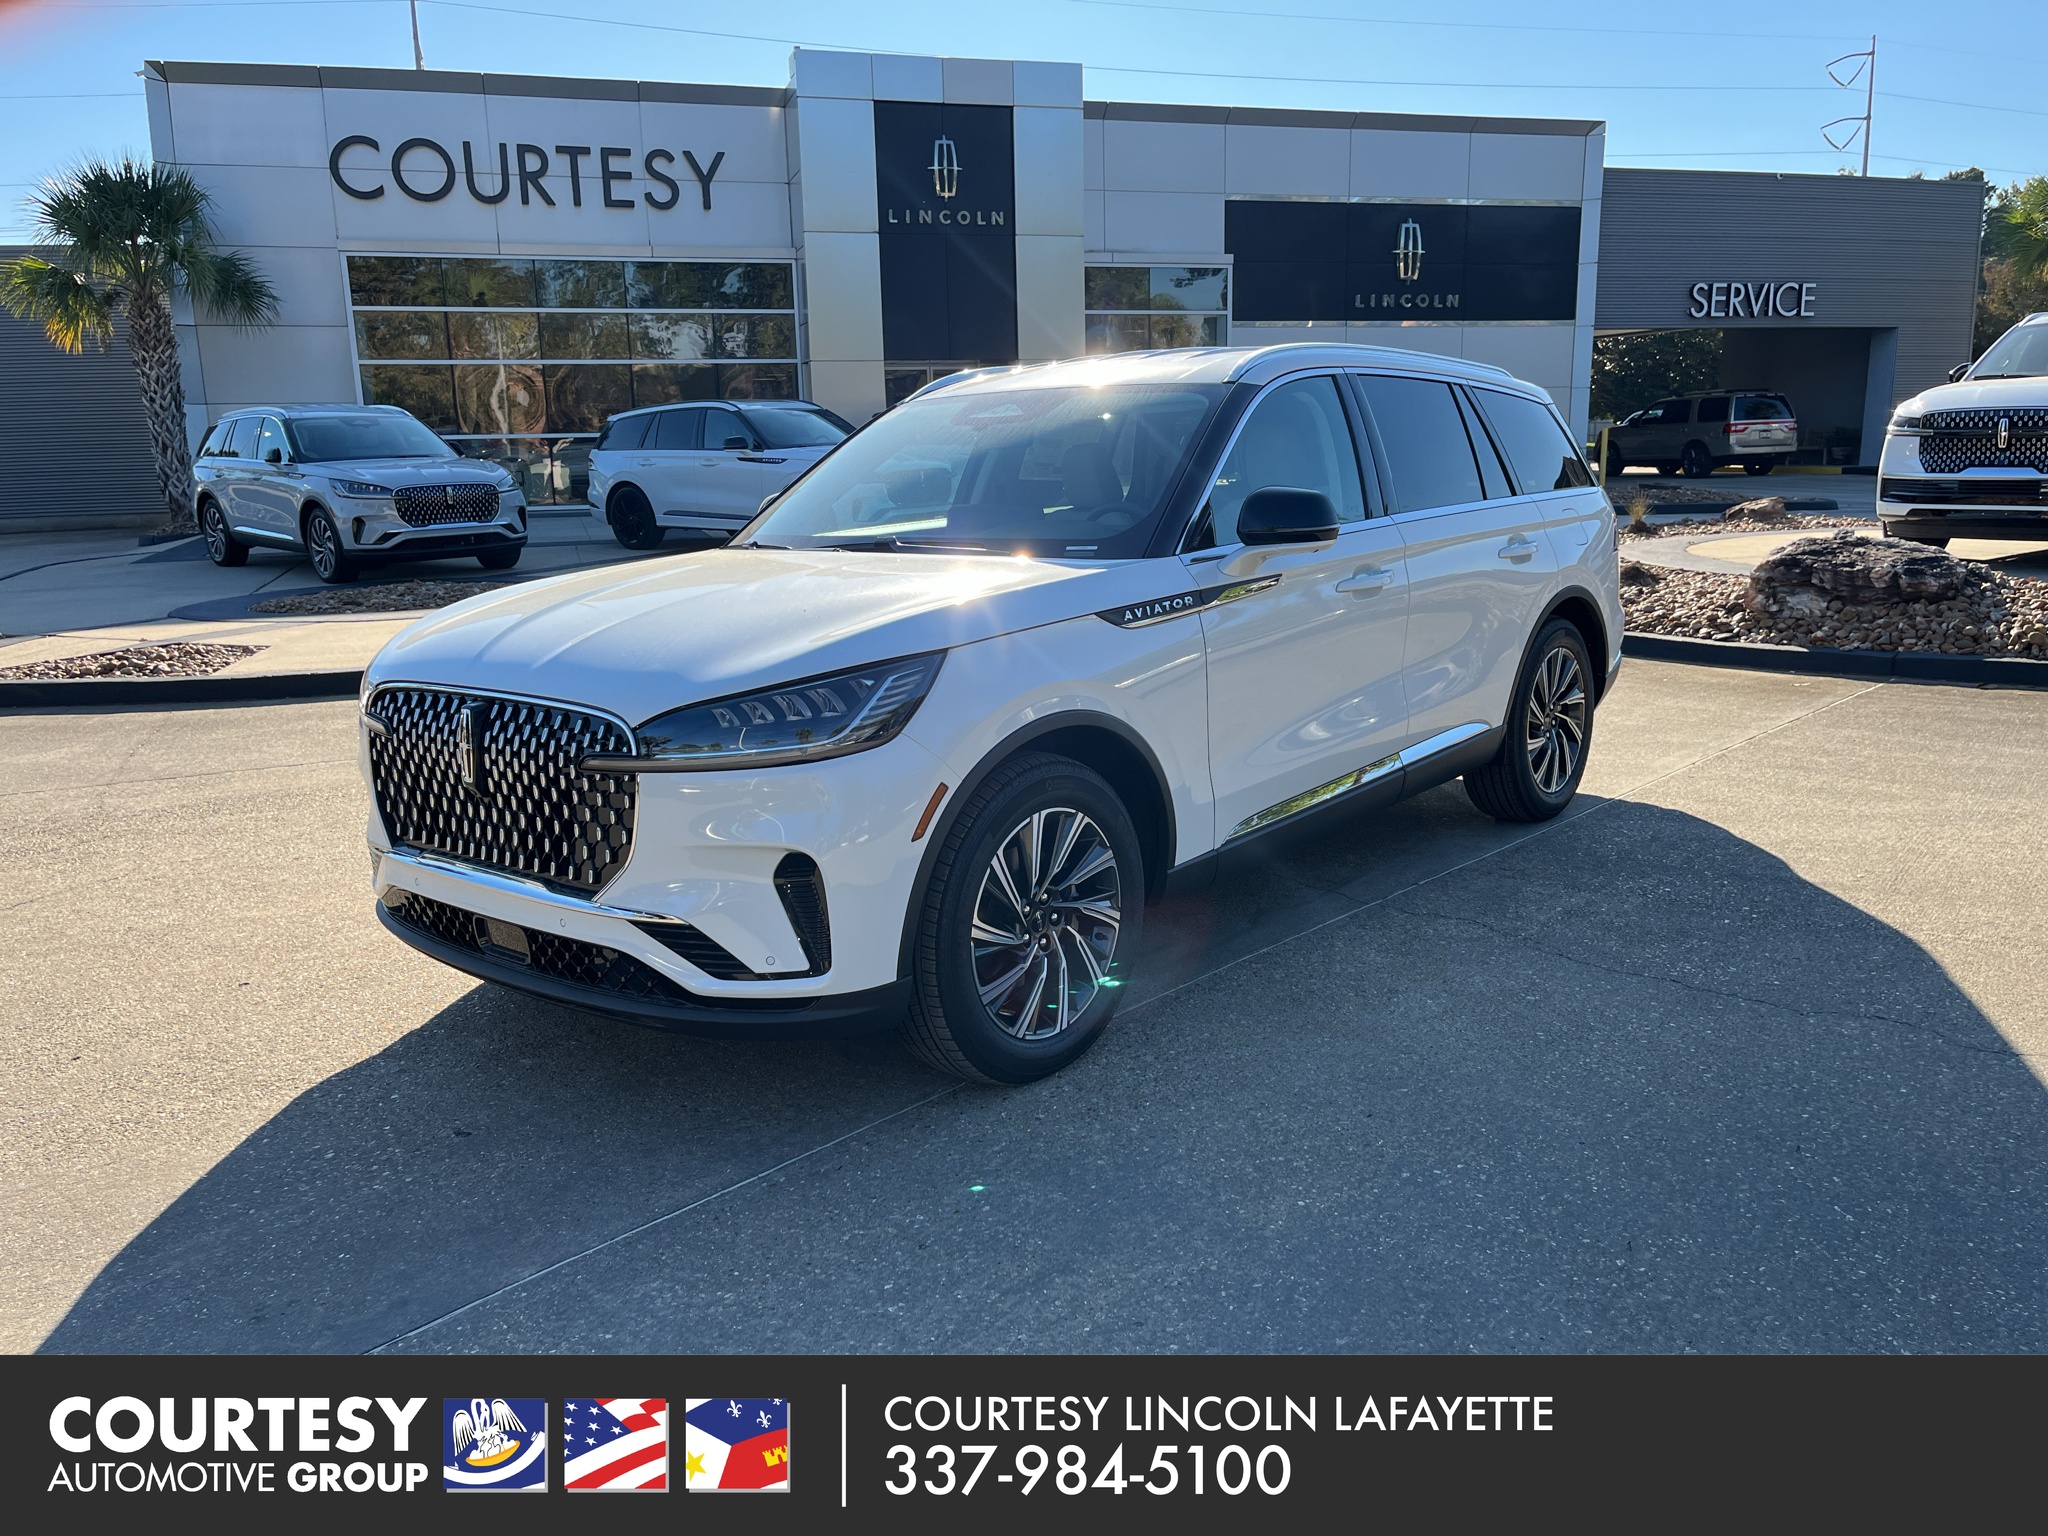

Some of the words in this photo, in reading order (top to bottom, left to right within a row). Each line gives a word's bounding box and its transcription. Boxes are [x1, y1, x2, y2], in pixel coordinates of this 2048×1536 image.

[329, 135, 725, 211] COURTESY
[888, 208, 1004, 226] LINCOLN
[1354, 293, 1460, 309] LINCOLN
[1689, 281, 1818, 318] SERVICE
[1123, 595, 1194, 622] AVIATOR
